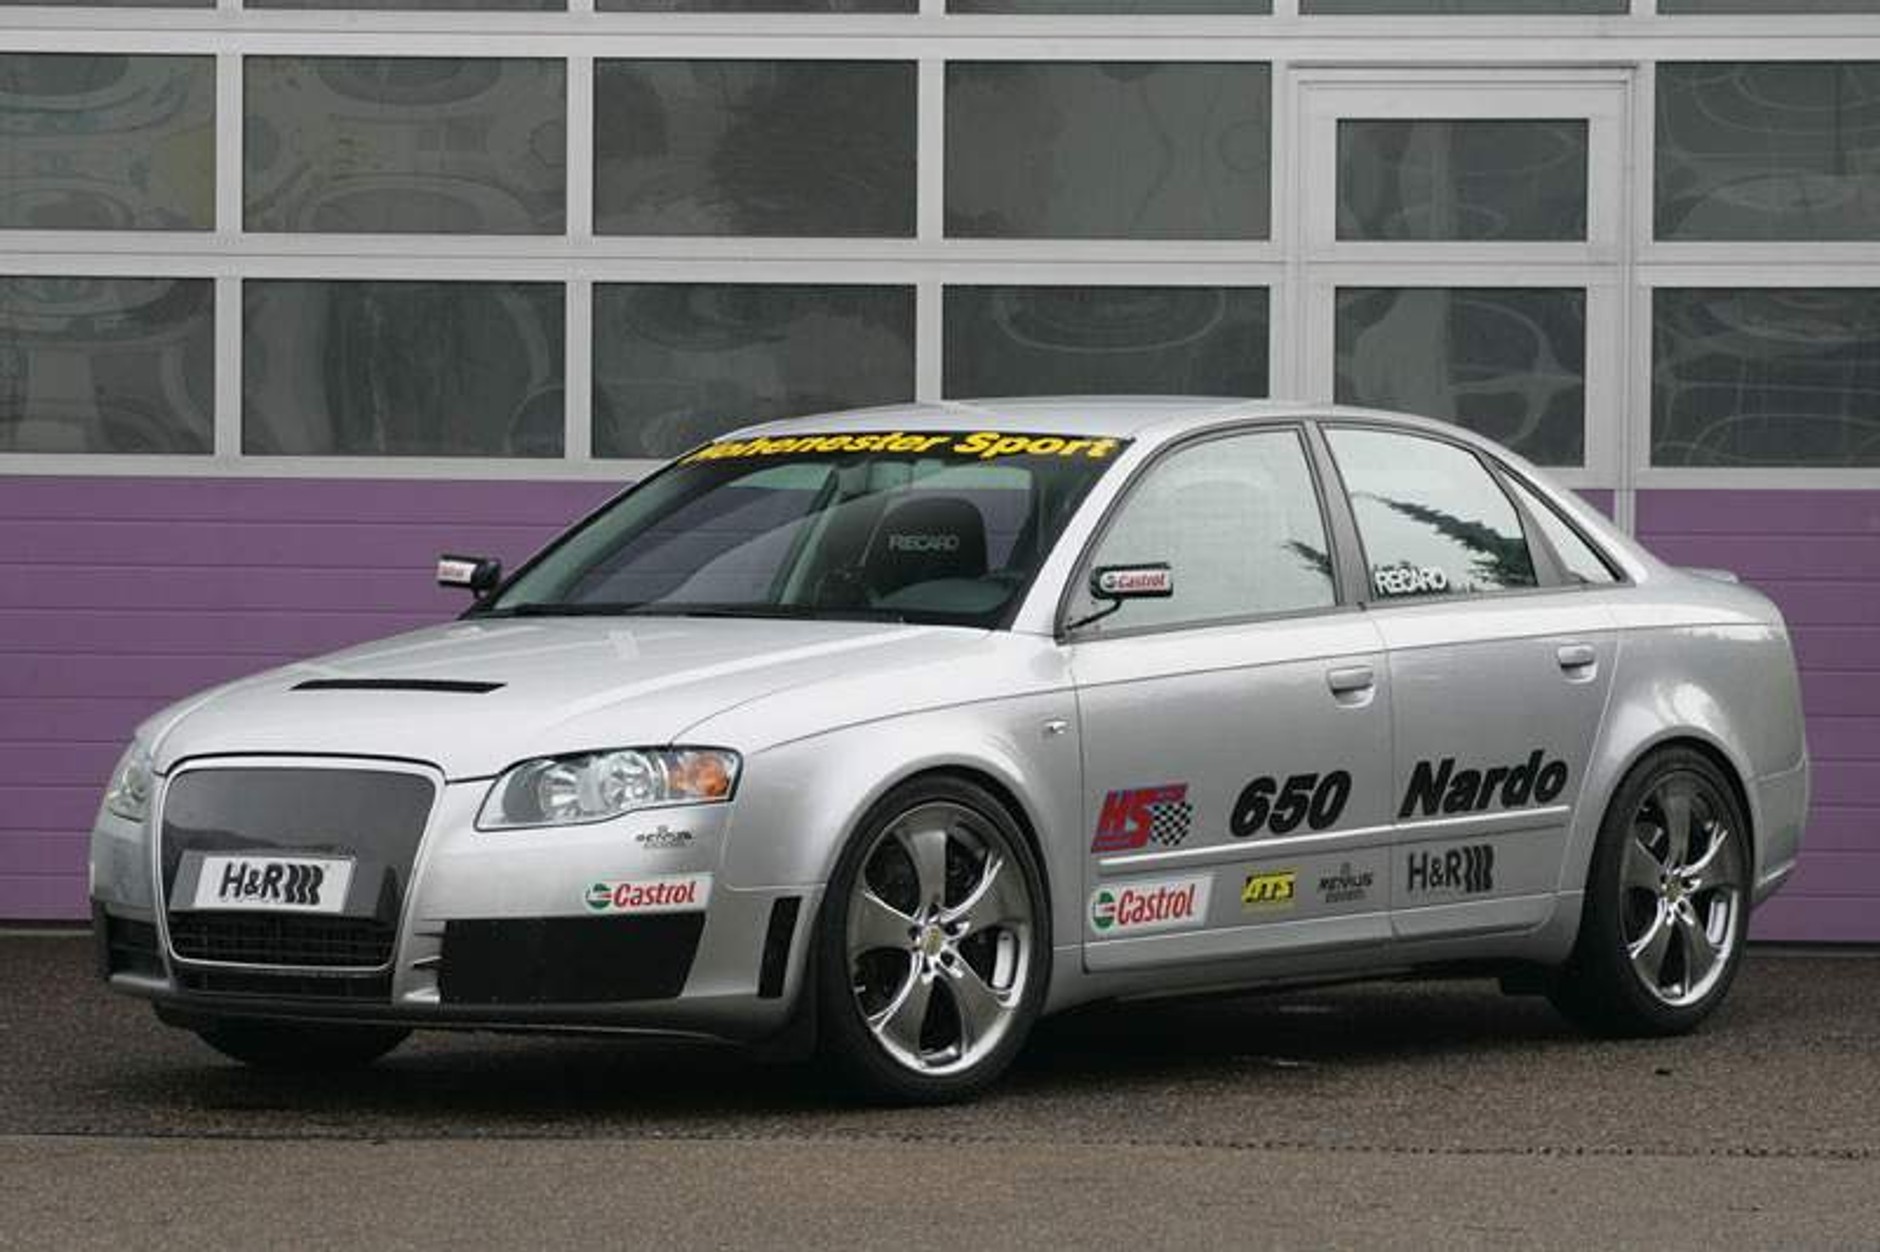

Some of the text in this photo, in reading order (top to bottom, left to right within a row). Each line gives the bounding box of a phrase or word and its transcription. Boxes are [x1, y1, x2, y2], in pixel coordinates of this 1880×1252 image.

[954, 431, 1118, 459] Sport
[1119, 573, 1165, 589] Castrol
[1398, 749, 1568, 818] Nardo
[1229, 770, 1352, 837] 650
[219, 862, 284, 898] H&R
[1407, 848, 1461, 892] H&R
[613, 881, 696, 907] Castrol
[1117, 883, 1196, 925] Castrol
